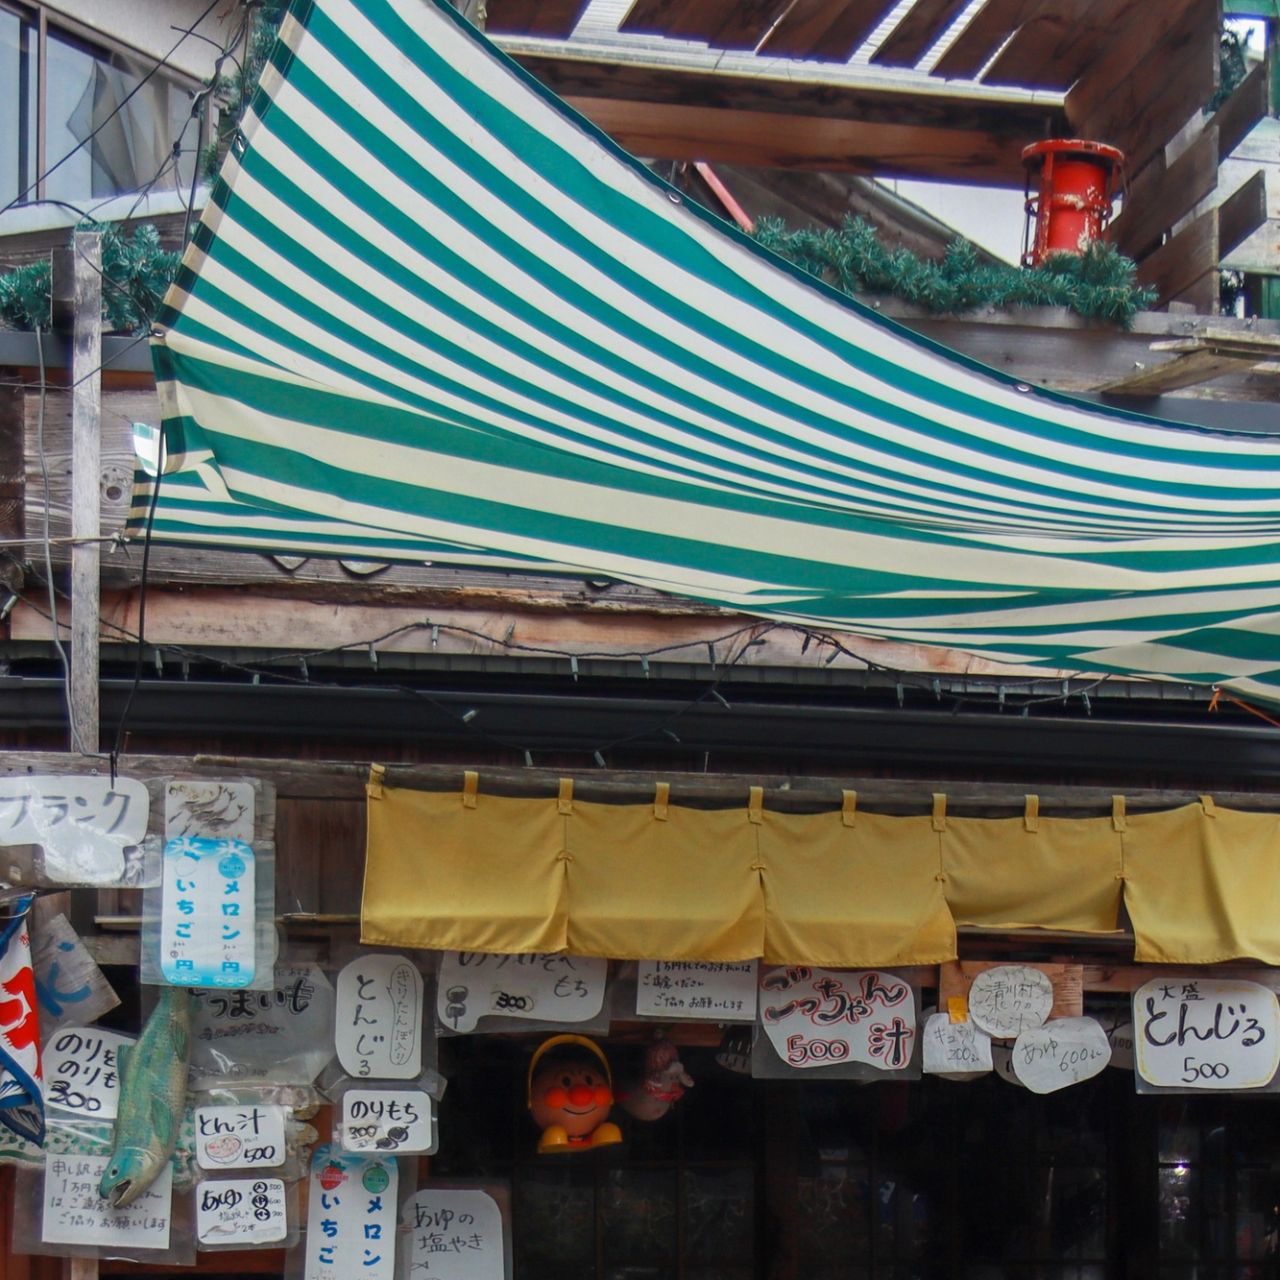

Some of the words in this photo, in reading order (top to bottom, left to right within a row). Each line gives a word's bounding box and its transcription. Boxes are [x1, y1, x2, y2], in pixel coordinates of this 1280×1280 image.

[176, 879, 196, 938] いちご
[222, 880, 240, 940] メロン
[553, 975, 588, 998] もち
[1158, 981, 1205, 1001] 大盛
[353, 974, 384, 1076] とんじる
[1144, 997, 1266, 1047] とんじる
[787, 1034, 850, 1066] 500
[869, 1017, 914, 1069] 汁
[1181, 1056, 1230, 1083] 500
[199, 1108, 266, 1135] とん汁
[350, 1100, 419, 1124] のりもち
[243, 1145, 276, 1163] 500
[319, 1193, 340, 1264] いちご
[363, 1196, 382, 1266] メロン
[414, 1202, 474, 1231] あゆの
[418, 1232, 484, 1253] 塩やき
